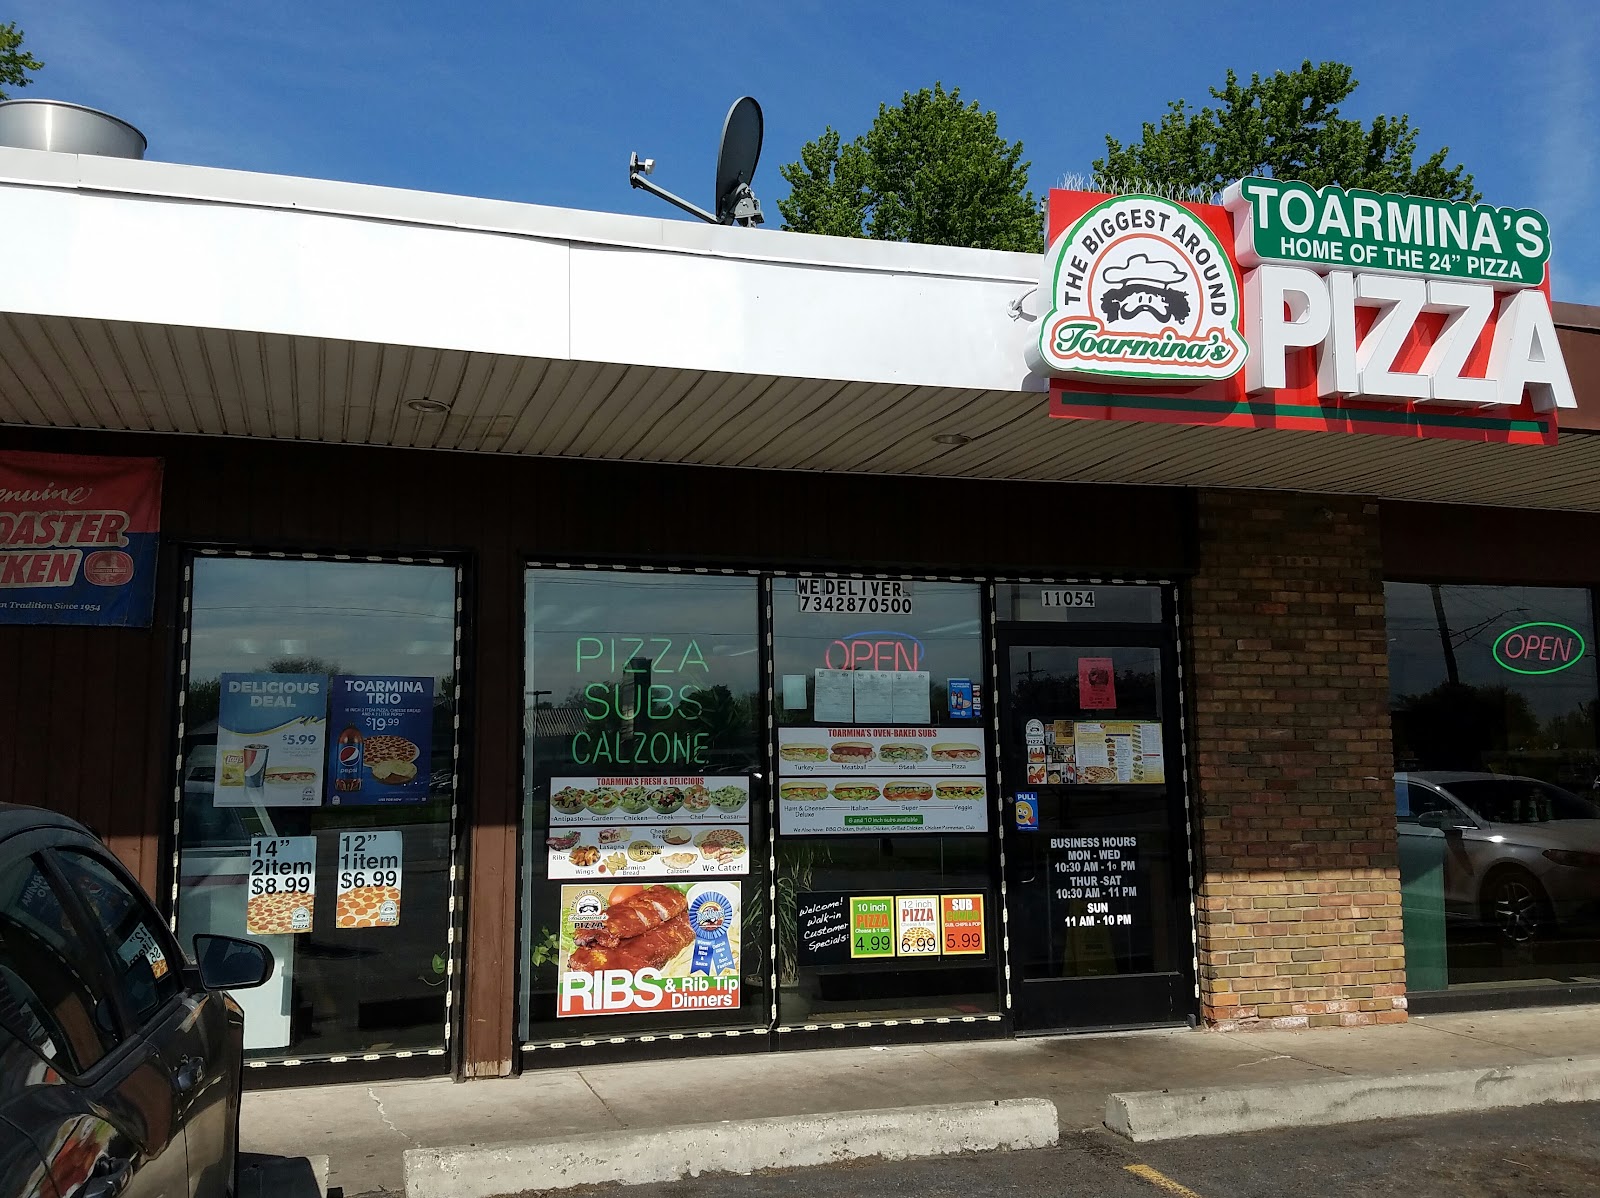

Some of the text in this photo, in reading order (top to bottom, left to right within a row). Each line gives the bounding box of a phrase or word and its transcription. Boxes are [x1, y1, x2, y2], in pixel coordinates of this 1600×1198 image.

[1247, 185, 1546, 260] TOARMINA'S
[1064, 208, 1228, 317] THE BIGGEST AROUND
[1280, 236, 1344, 262] HOME
[1349, 243, 1378, 265] OF
[1383, 246, 1424, 269] THE
[1467, 256, 1524, 280] PIZZA
[1056, 322, 1232, 364] Toarmina's
[1260, 264, 1577, 410] PIZZA
[0, 553, 78, 584] KEN
[798, 579, 902, 597] WE DELIVER
[801, 596, 912, 614] 7342870500
[1044, 591, 1094, 606] 11054
[10, 601, 53, 610] Tradition
[54, 602, 79, 610] Since
[80, 603, 101, 612] 1954
[1504, 633, 1573, 662] OPEN
[576, 637, 710, 673] PIZZA
[825, 640, 918, 671] OPEN
[228, 681, 320, 695] DELICIOUS
[344, 680, 425, 693] TOARMINA
[250, 695, 297, 708] DEAL
[366, 692, 402, 705] TRIO
[583, 683, 703, 720] SUBS
[366, 717, 400, 731] $19.99
[282, 734, 317, 746] $5.99
[828, 729, 937, 738] TOARMINA'S OVEN-BAKED SUBS
[571, 730, 710, 765] CALZONE
[597, 777, 705, 786] TOARMINA'S FRESH & DELICIOUS
[1017, 793, 1036, 801] PULL
[901, 804, 919, 812] Super
[1050, 837, 1137, 849] BUSINESS HOURS
[1067, 850, 1091, 861] MON
[1099, 849, 1121, 860] WED
[702, 864, 744, 872] We Cater!
[1054, 862, 1081, 873] 10:30
[1083, 862, 1099, 872] AM
[1120, 860, 1136, 871] PM
[251, 876, 310, 895] $8.99
[340, 870, 397, 889] $6.99
[1069, 876, 1098, 887] THUR
[1055, 888, 1083, 899] 10:30
[1084, 888, 1100, 898] AM
[1108, 887, 1119, 897] 11
[1122, 886, 1137, 897] PM
[799, 896, 844, 917] Welcome!
[857, 903, 887, 912] 10 inch
[903, 899, 933, 909] 12 inch
[952, 899, 973, 911] SUB
[1087, 902, 1109, 913] SUN
[855, 914, 889, 928] PIZZA
[902, 908, 934, 922] PIZZA
[946, 910, 979, 921] COMBO
[1064, 916, 1077, 927] 11
[1079, 915, 1095, 926] AM
[1102, 915, 1115, 925] 10
[1116, 914, 1132, 925] PM
[803, 923, 849, 939] Customer
[855, 935, 890, 951] 4.99
[901, 937, 936, 952] 6.99
[946, 933, 980, 948] 5.99
[562, 967, 664, 1012] RIBS
[664, 975, 739, 993] & Rib Tip
[672, 993, 733, 1009] Dinners
